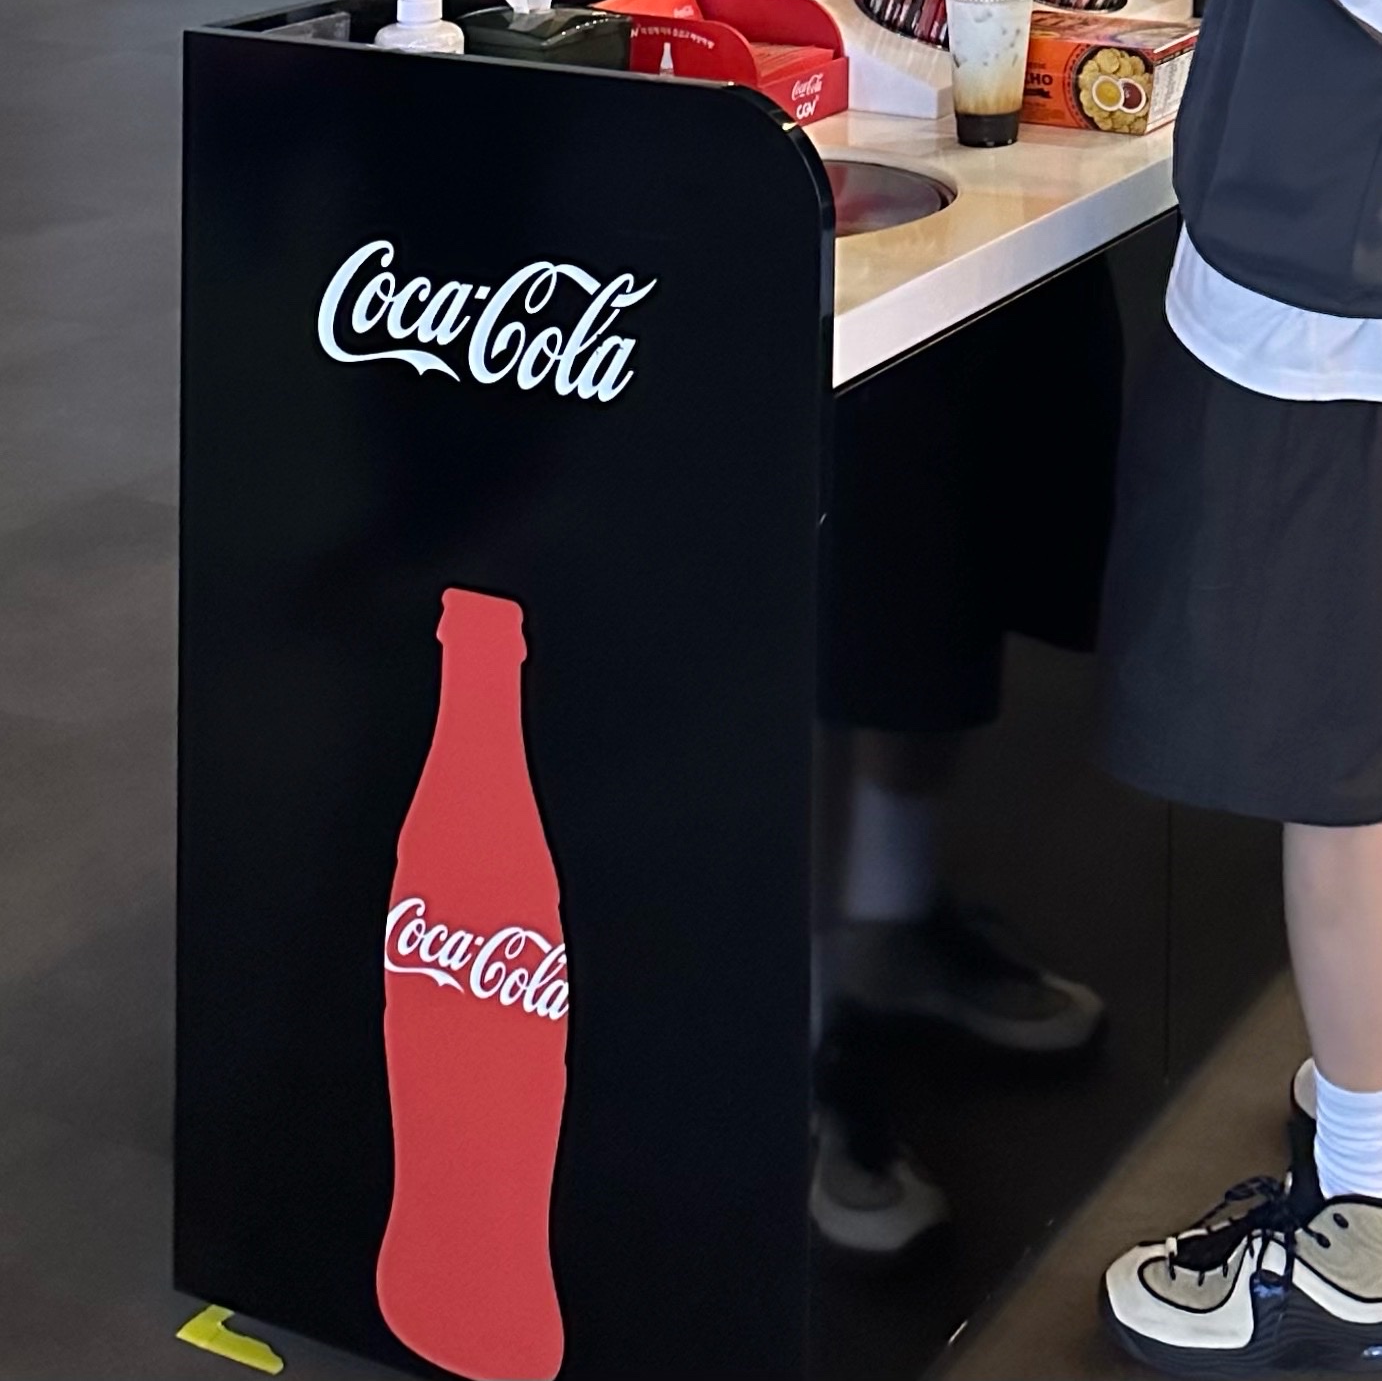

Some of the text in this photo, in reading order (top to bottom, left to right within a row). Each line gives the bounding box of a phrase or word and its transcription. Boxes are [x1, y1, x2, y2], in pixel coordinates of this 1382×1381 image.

[791, 73, 824, 102] Coca-Cola
[317, 239, 658, 403] Coca-Cola
[383, 897, 569, 1022] Coca-Cola
